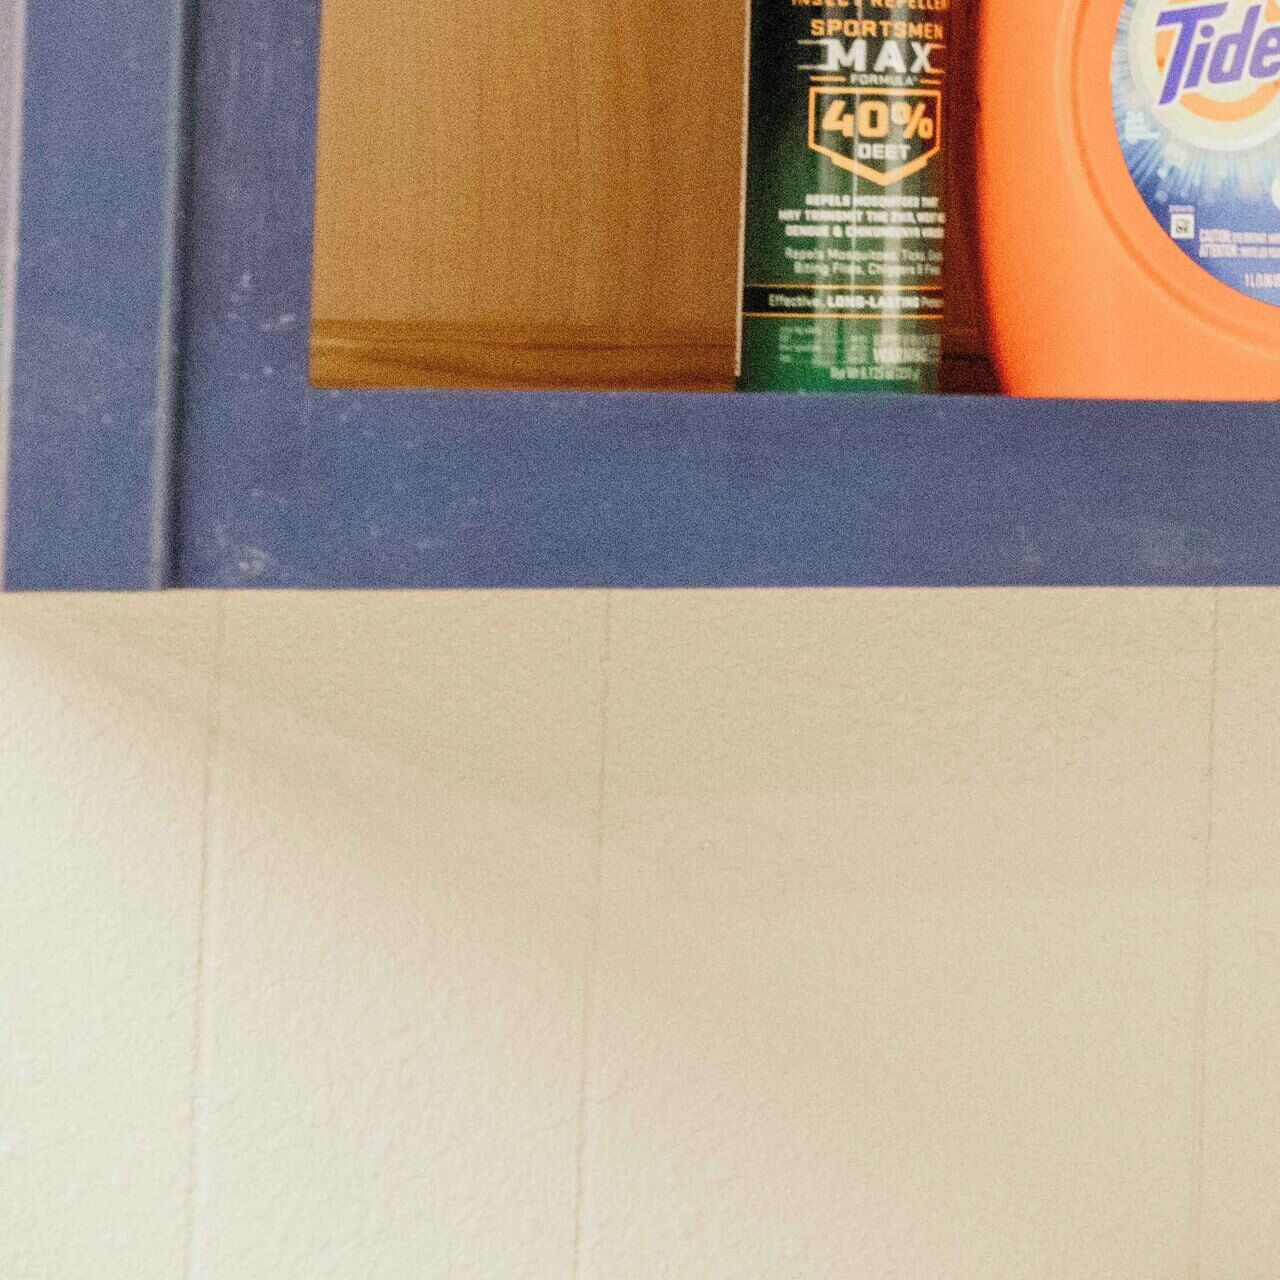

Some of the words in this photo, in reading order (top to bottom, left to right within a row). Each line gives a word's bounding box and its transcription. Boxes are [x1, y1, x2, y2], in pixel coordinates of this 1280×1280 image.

[809, 18, 944, 40] SPORTSMEN
[826, 38, 935, 74] MAX
[821, 99, 934, 141] 40%
[857, 143, 911, 161] DEET
